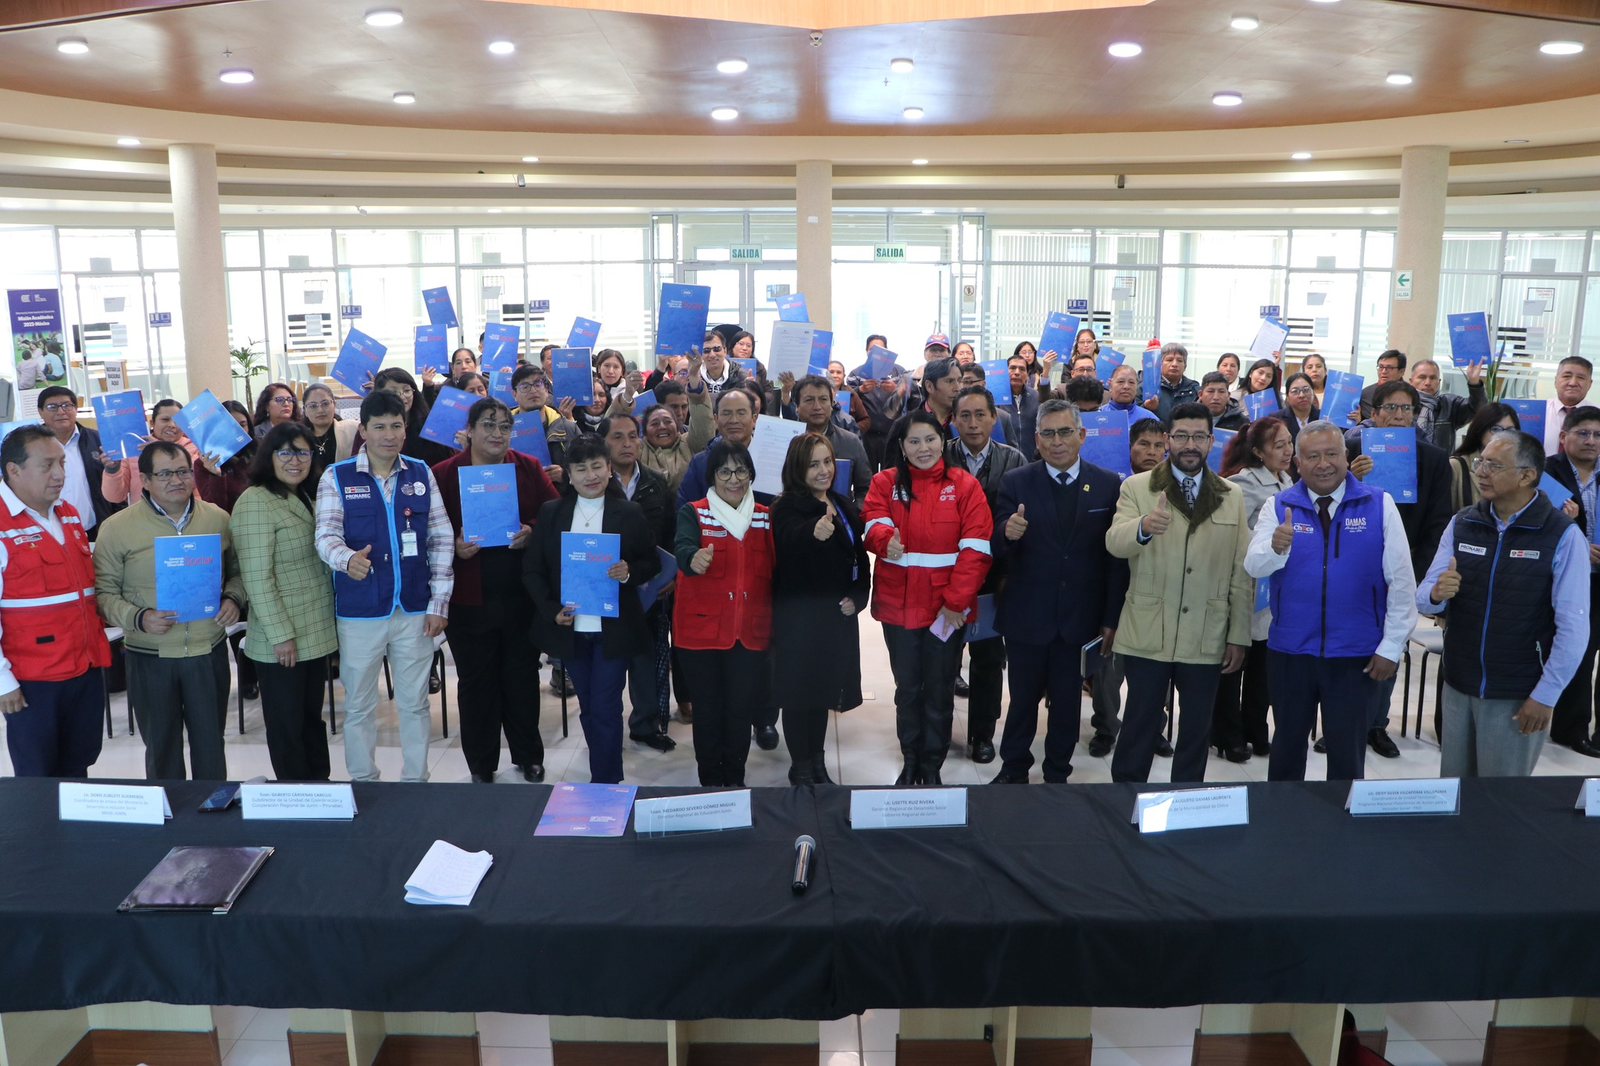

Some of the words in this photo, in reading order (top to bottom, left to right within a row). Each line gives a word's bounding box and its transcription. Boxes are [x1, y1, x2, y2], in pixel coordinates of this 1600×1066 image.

[732, 248, 759, 258] SALIDA
[876, 248, 904, 258] SALIDA
[682, 301, 703, 309] Social
[517, 428, 538, 436] Social
[1100, 427, 1122, 436] Social
[1386, 444, 1409, 452] Social
[485, 483, 509, 492] Social
[1346, 517, 1366, 526] DAMAS
[1461, 544, 1484, 553] PRONABEC
[184, 556, 213, 566] Social
[587, 552, 612, 562] Social
